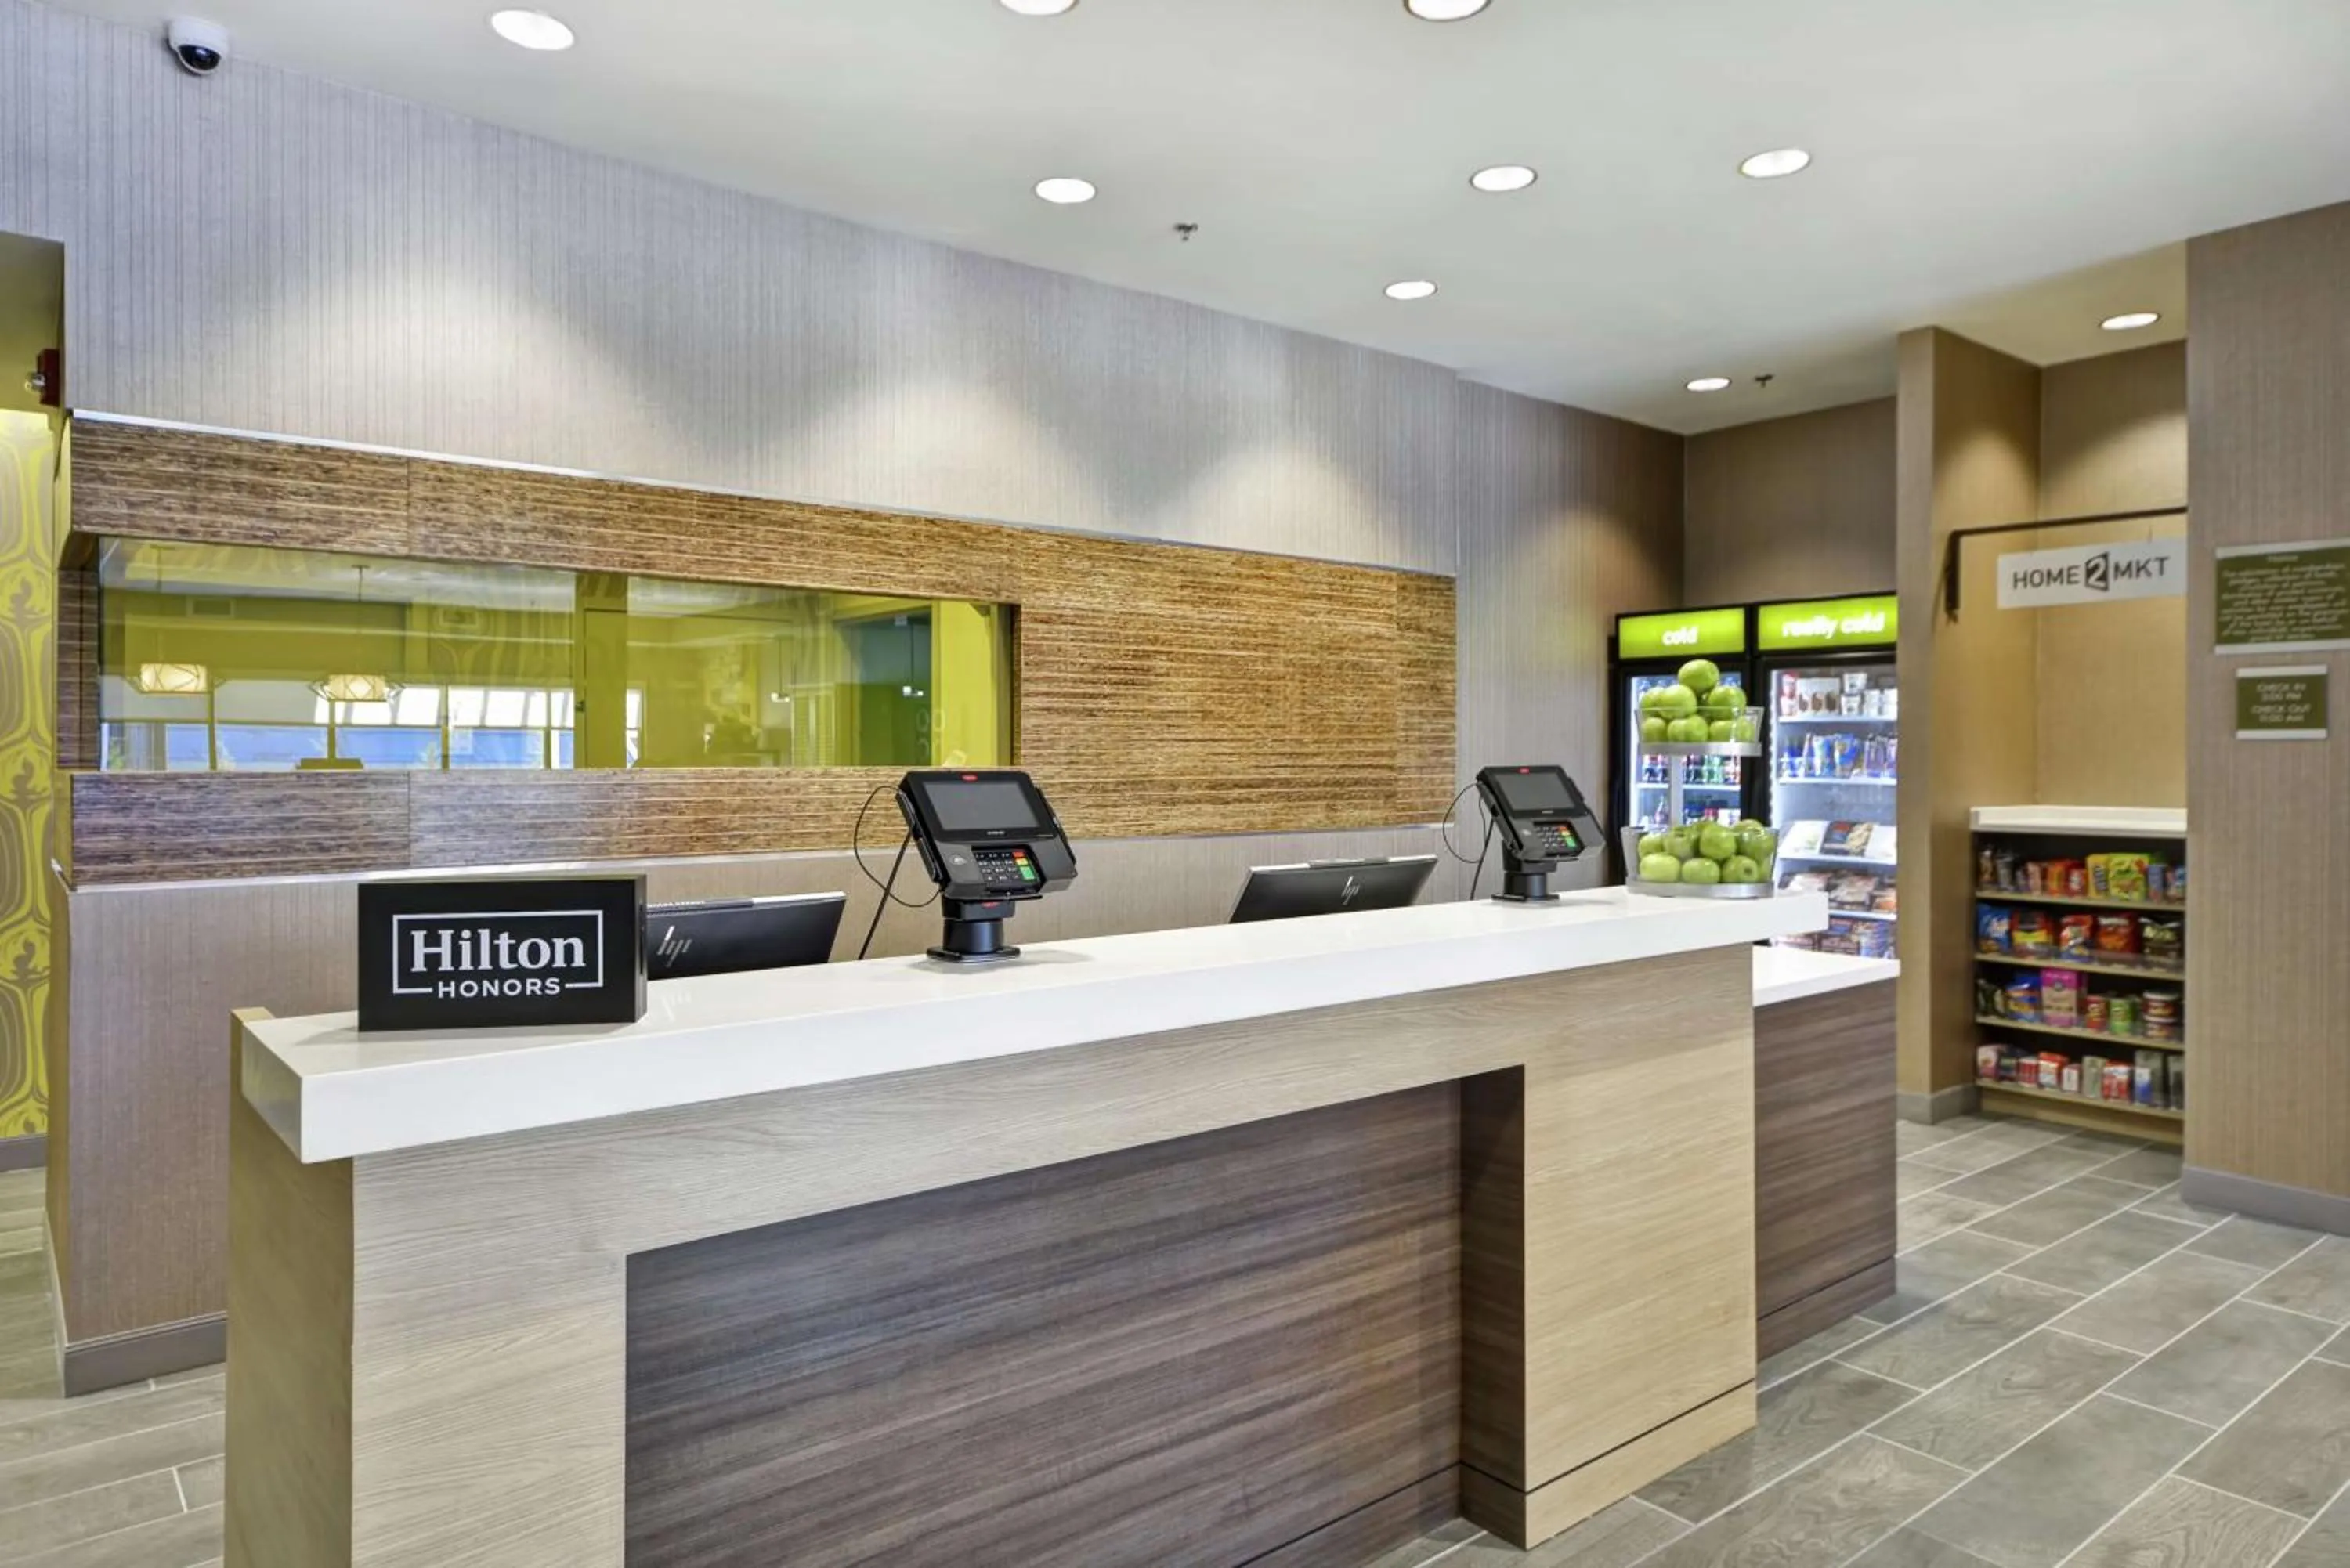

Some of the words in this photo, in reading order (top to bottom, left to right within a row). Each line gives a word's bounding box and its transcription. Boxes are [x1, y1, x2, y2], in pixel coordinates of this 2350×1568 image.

[2013, 565, 2081, 590] HOME
[2114, 556, 2171, 581] MKT
[1841, 611, 1885, 634] cold
[1662, 626, 1698, 646] cold
[410, 928, 586, 972] Hilton
[438, 977, 561, 999] HONORS
